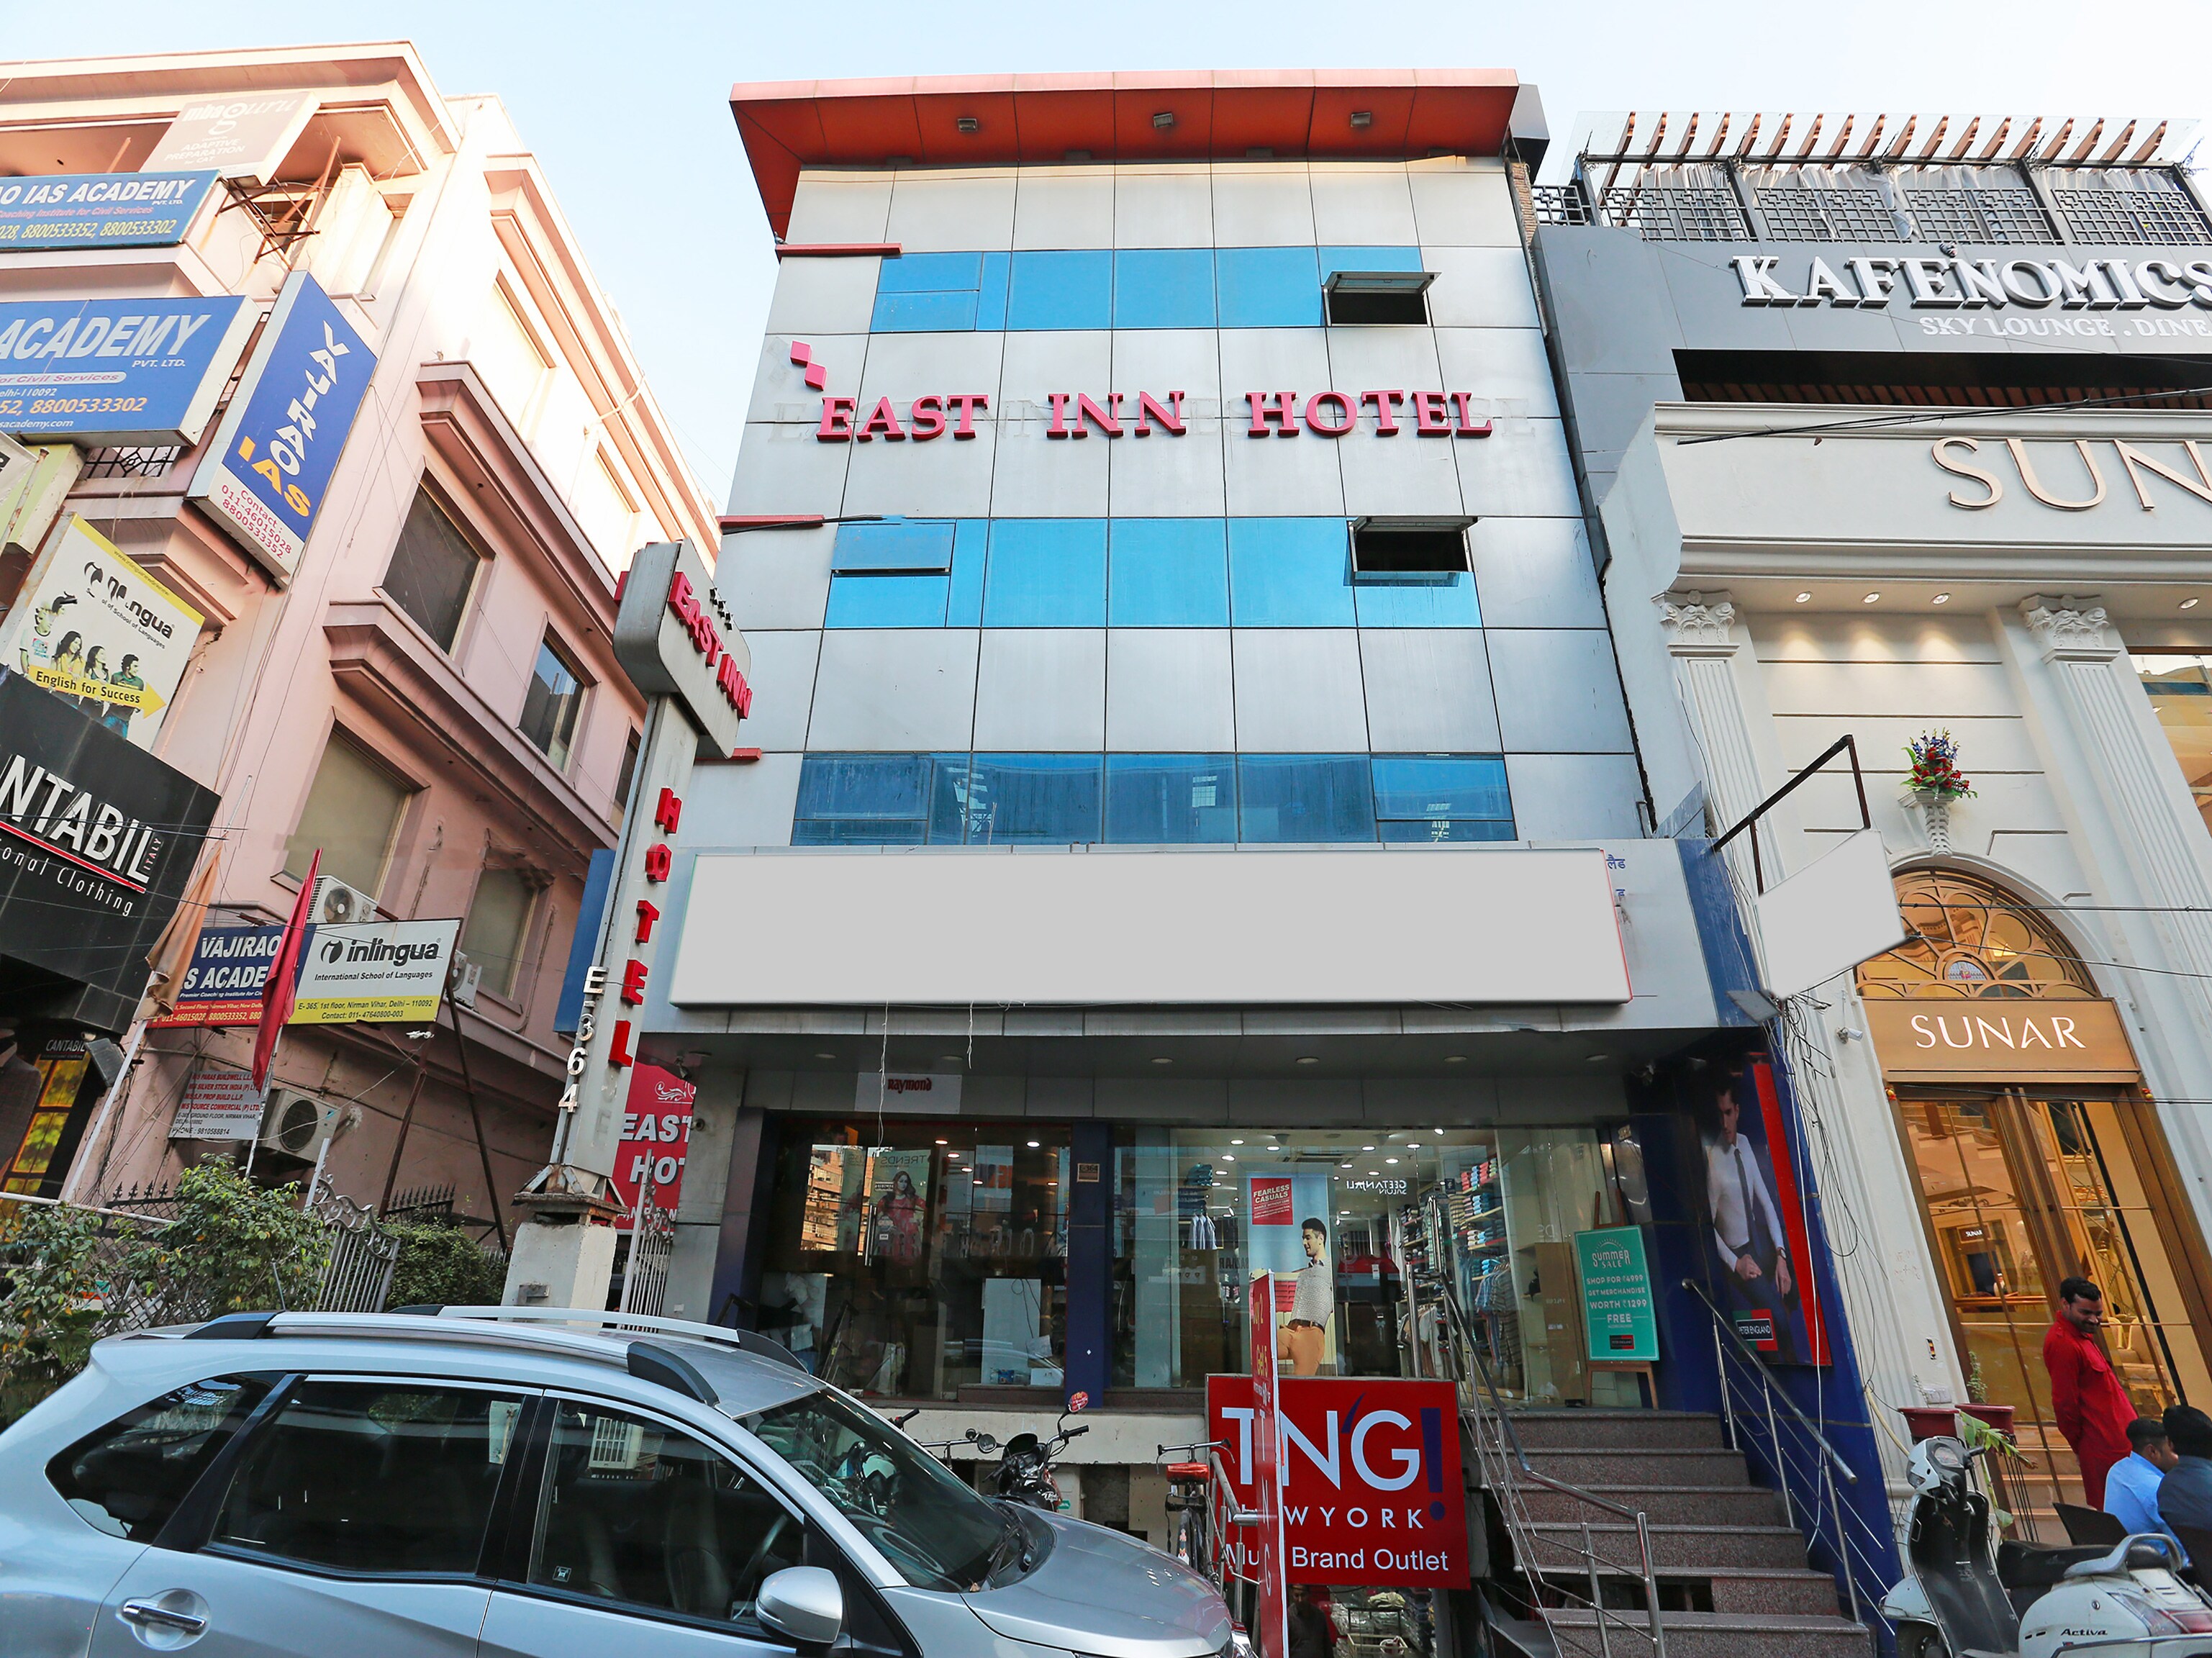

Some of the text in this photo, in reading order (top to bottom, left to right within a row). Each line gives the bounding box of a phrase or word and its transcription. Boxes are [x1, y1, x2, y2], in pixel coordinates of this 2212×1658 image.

[164, 145, 246, 161] PREPARATION
[181, 139, 241, 152] ADAPTIVE
[0, 179, 196, 205] O IAS ACADEMY
[36, 207, 78, 217] Institute
[91, 207, 113, 216] Civil
[113, 206, 154, 215] Services
[21, 222, 99, 240] 8800533352,
[99, 219, 178, 237] 8800533302
[1733, 255, 2212, 309] KAFENOMICS
[0, 314, 212, 360] ACADEMY
[1919, 317, 2212, 338] SKY LOUNGE DINE
[132, 359, 186, 368] PVT. LTD.
[17, 373, 51, 384] Civil
[53, 373, 120, 383] Services
[29, 397, 148, 414] 8800533302
[817, 391, 1493, 442] EAST INN HOTEL
[237, 435, 312, 518] IAS
[1931, 435, 2212, 512] SUN
[222, 484, 292, 554] 011-46015028
[240, 489, 277, 528] Contact
[222, 499, 284, 559] 8800533352
[668, 571, 753, 720] EAST INN
[36, 670, 141, 704] English for Success
[0, 754, 153, 884] NTABIL
[143, 837, 163, 871] ITALY
[0, 838, 134, 917] onal Clothing
[608, 787, 682, 1068] HOTEL
[201, 935, 282, 959] VAJIRAO
[346, 937, 439, 966] inlingua
[199, 965, 270, 989] ACADE
[314, 971, 359, 982] International
[360, 971, 385, 980] School
[394, 970, 433, 980] Languages
[322, 1011, 347, 1020] Contact:
[370, 1000, 386, 1009] Vihar,
[1910, 1014, 2087, 1049] SUNAR
[887, 1077, 932, 1094] Raymond
[629, 1155, 686, 1184] HO
[1253, 1184, 1289, 1198] FEARLESS
[1255, 1191, 1288, 1204] CASUALS
[1592, 1249, 1632, 1267] SUMMER
[1602, 1261, 1622, 1269] SALE
[1586, 1277, 1605, 1285] SHOP
[1600, 1287, 1646, 1296] MERCHANDISE
[1589, 1300, 1621, 1310] WORTH
[1607, 1313, 1632, 1324] FREE
[1292, 1545, 1365, 1570] Brand
[1374, 1548, 1449, 1572] Outlet
[2060, 1628, 2108, 1636] Activa
